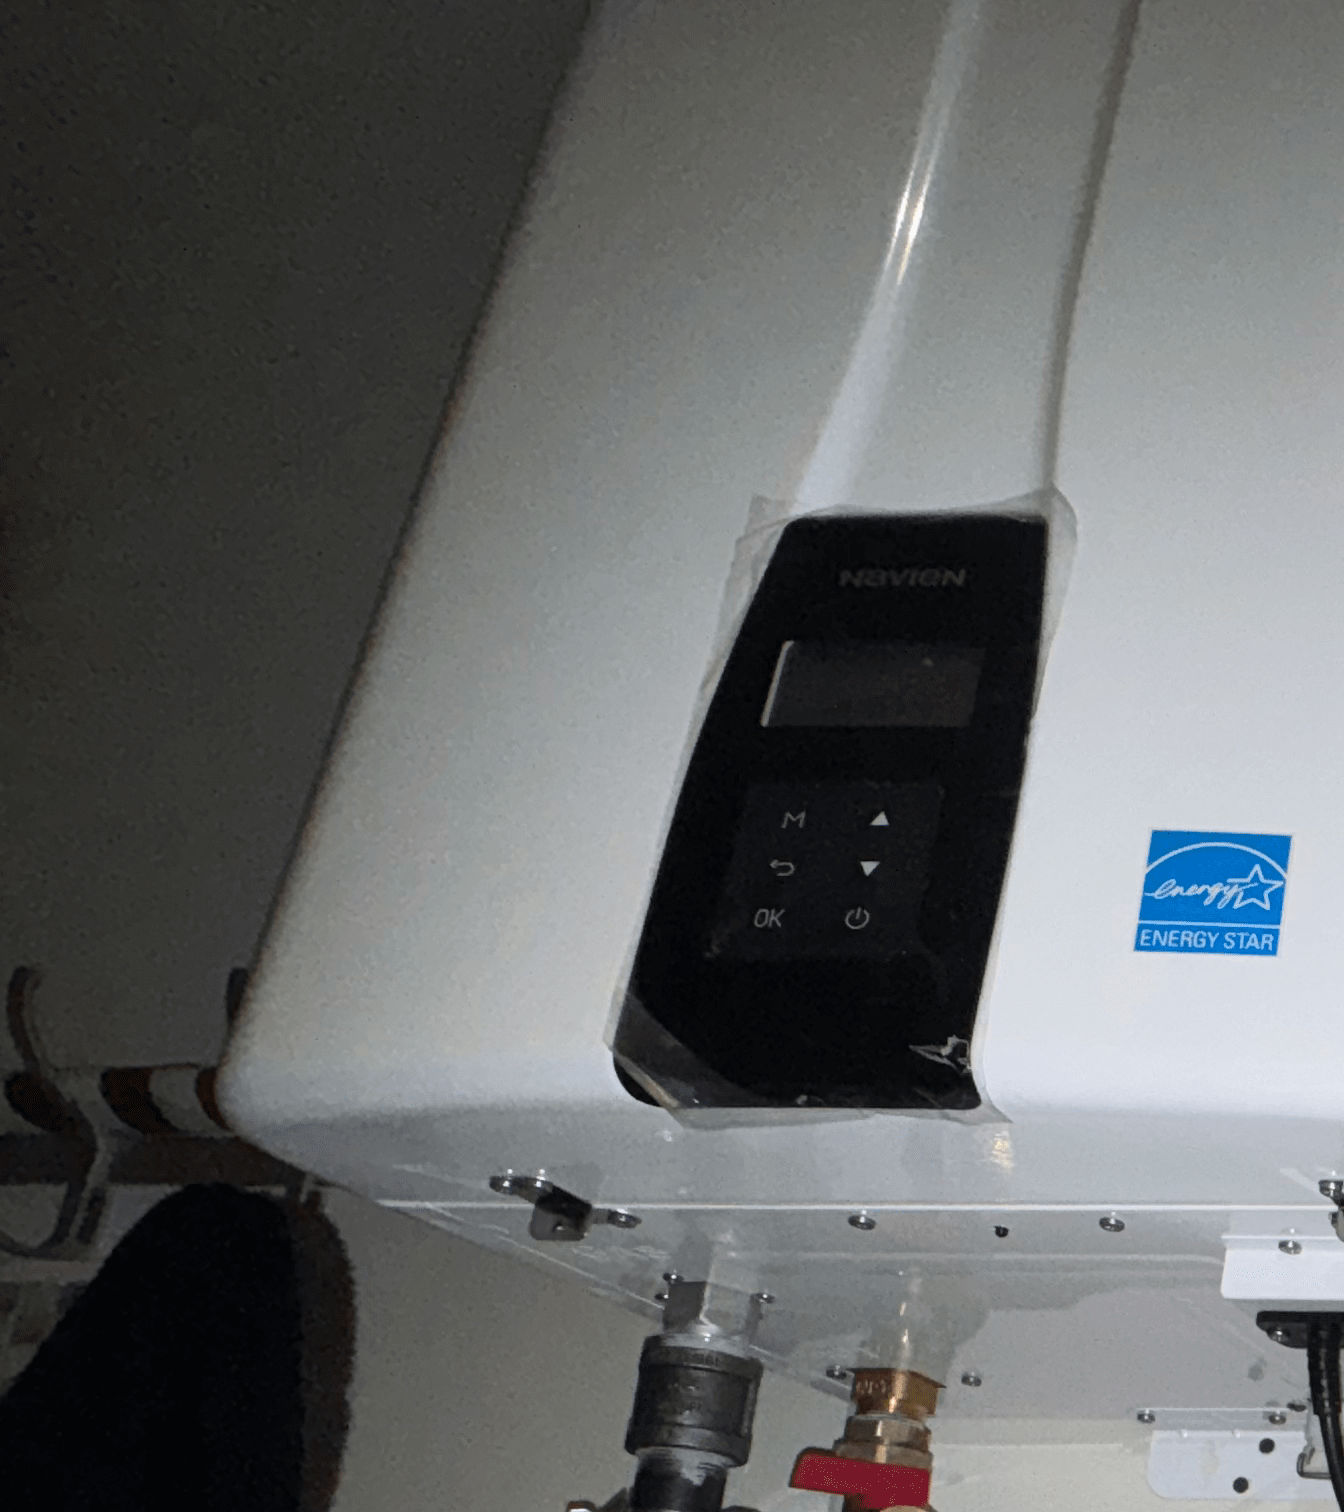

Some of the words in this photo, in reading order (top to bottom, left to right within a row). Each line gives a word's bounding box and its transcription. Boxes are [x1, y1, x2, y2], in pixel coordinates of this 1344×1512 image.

[781, 810, 806, 829] M
[1145, 878, 1241, 909] energy
[754, 908, 786, 928] OK
[1140, 928, 1219, 949] ENERGY
[1223, 931, 1275, 951] STAR
